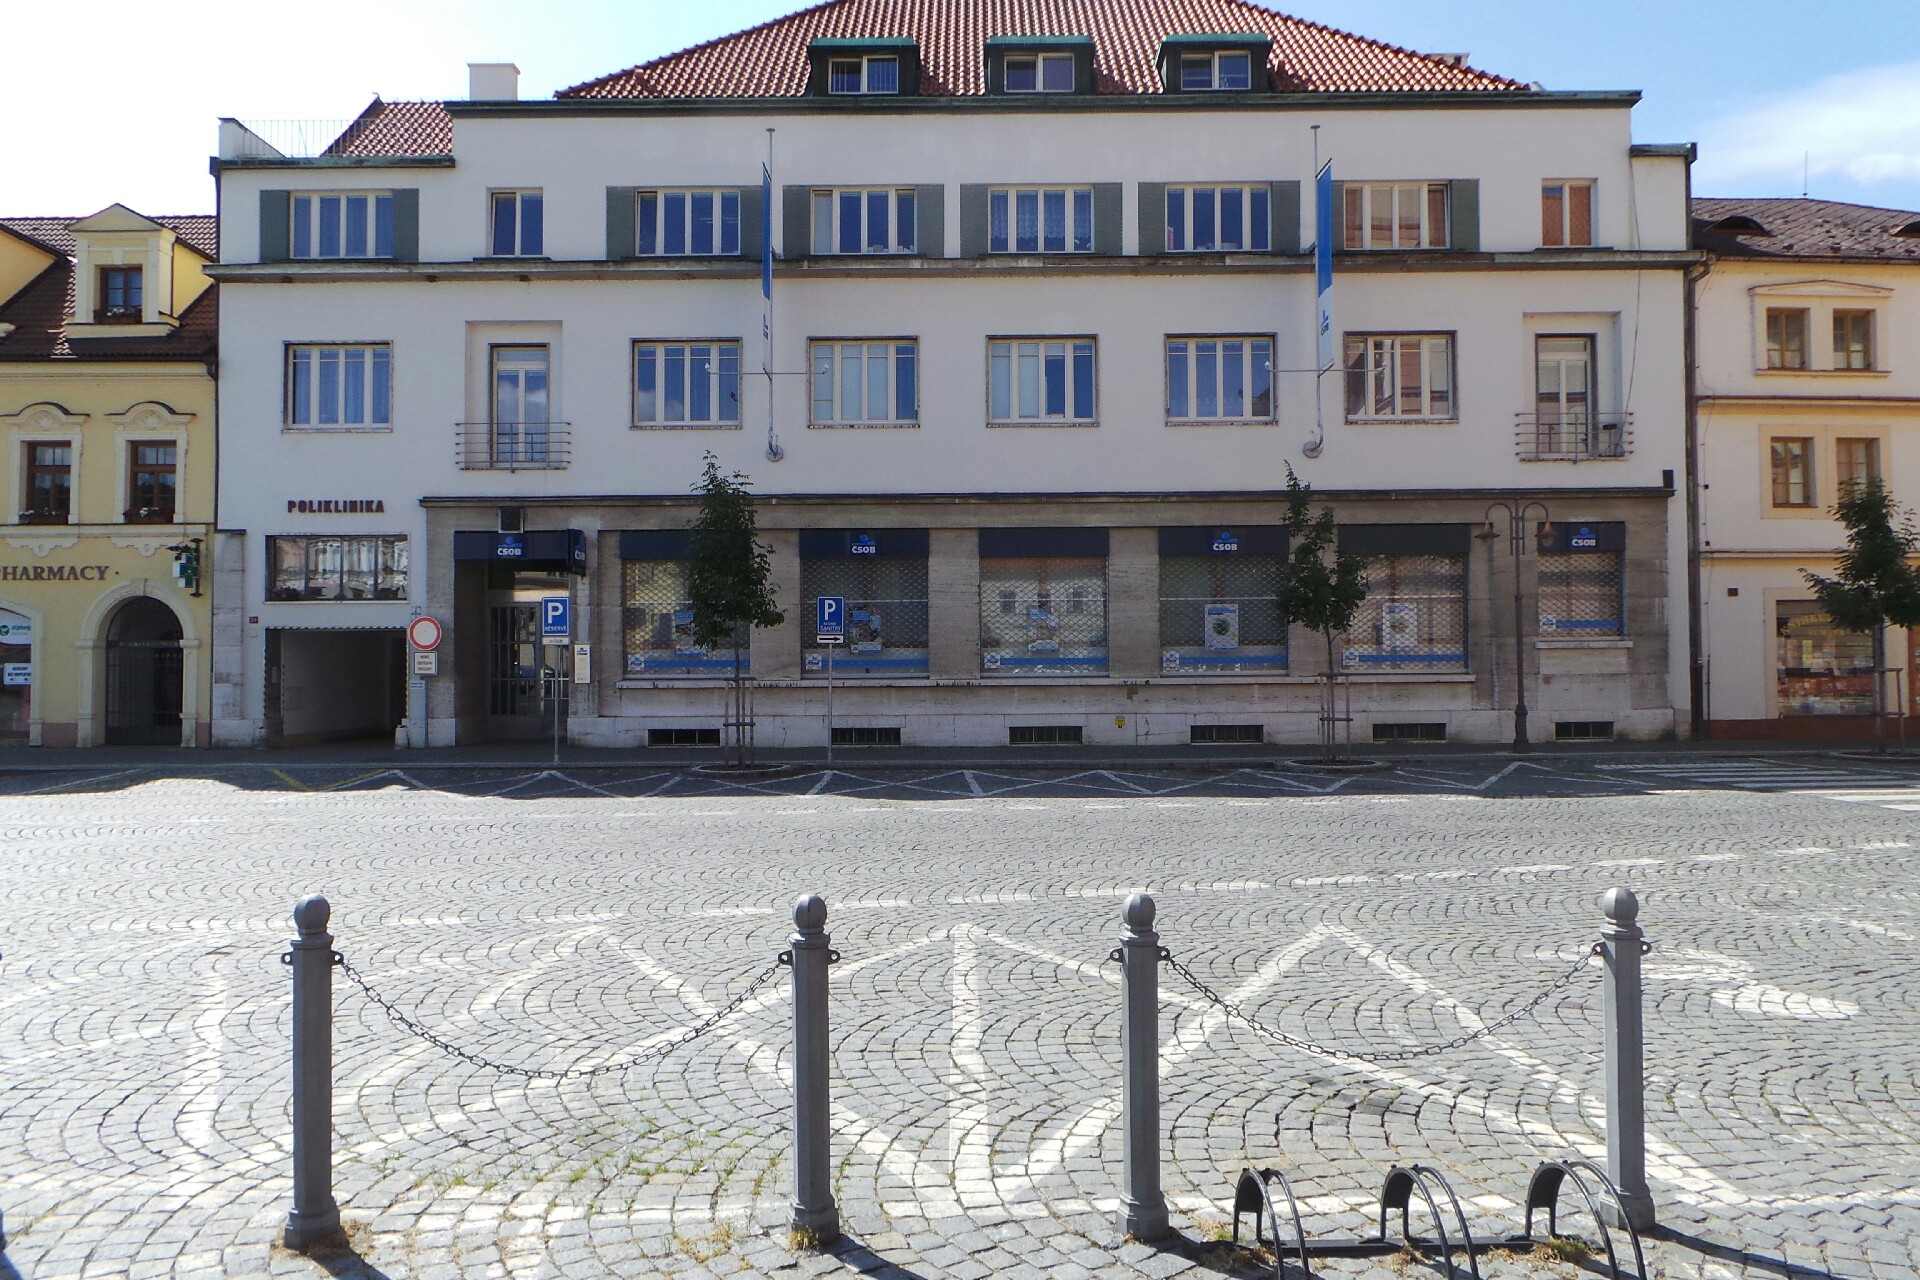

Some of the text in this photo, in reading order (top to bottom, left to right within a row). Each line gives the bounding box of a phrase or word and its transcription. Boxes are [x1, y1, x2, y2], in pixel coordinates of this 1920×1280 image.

[287, 500, 385, 513] POLIKLINIKA
[497, 546, 522, 556] ČSOB
[851, 544, 876, 554] ČSOB
[1212, 542, 1238, 551] ČSOB
[0, 565, 109, 581] HARMACY
[547, 602, 564, 624] P
[825, 599, 836, 620] P
